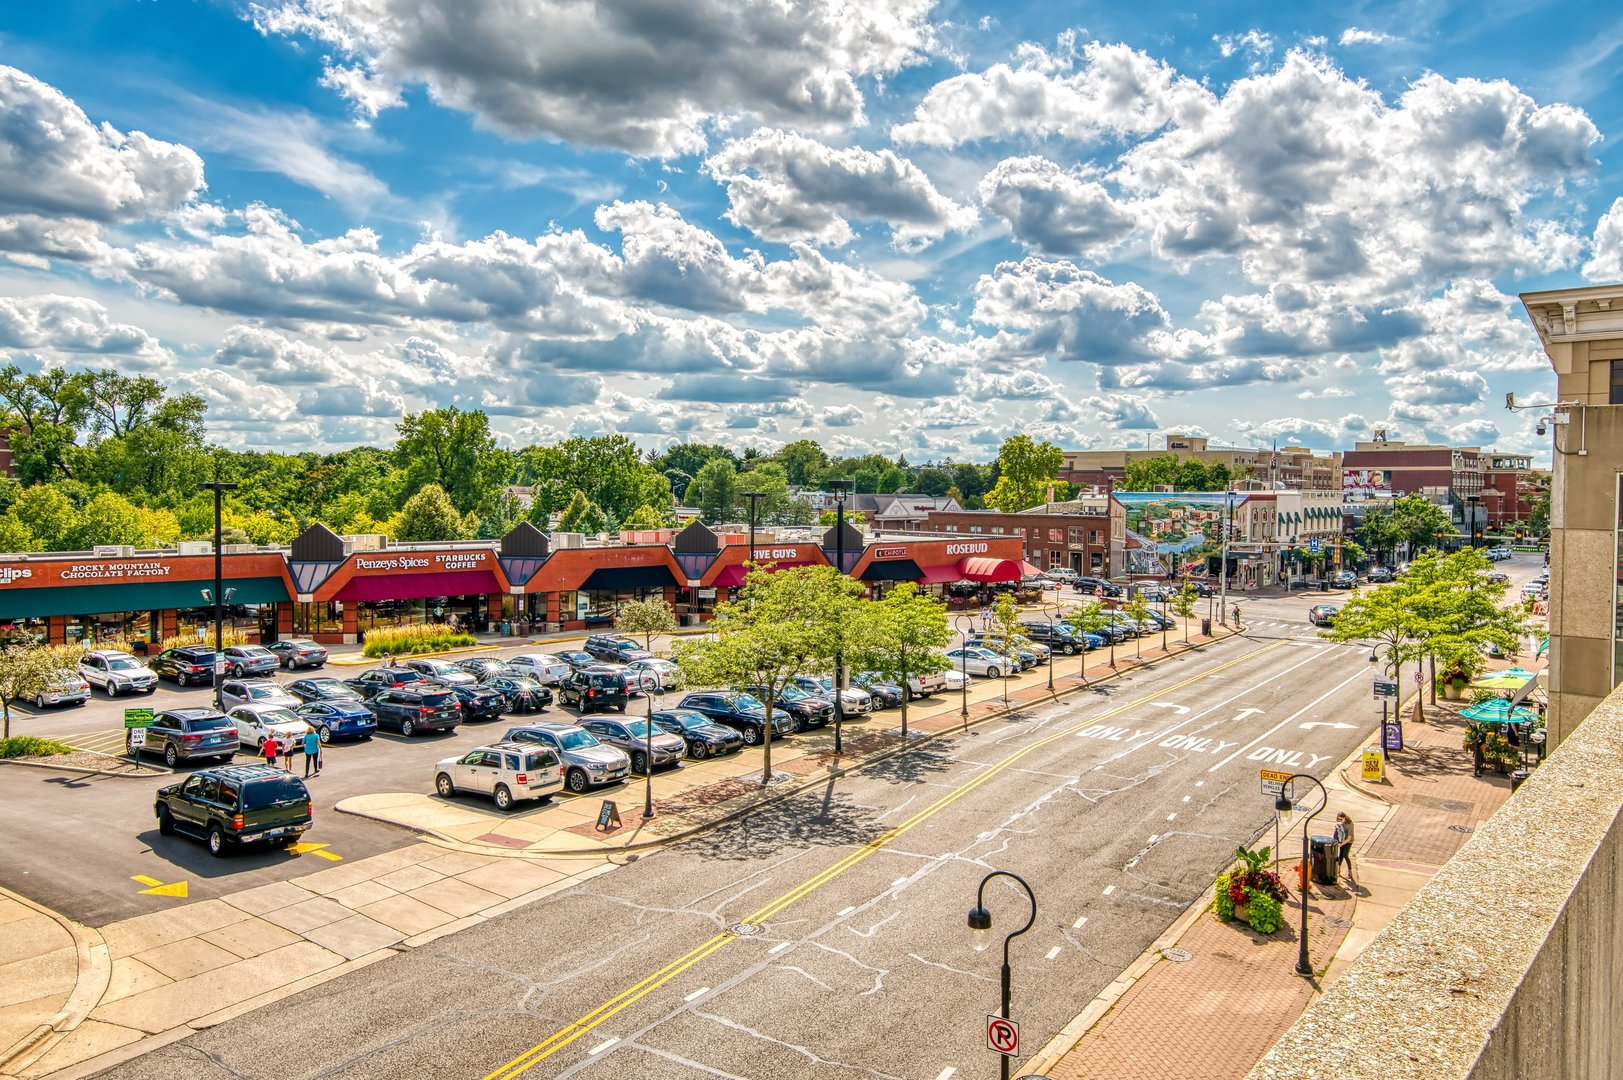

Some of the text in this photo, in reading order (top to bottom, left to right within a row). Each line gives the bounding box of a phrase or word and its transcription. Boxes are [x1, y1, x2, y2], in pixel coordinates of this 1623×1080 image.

[771, 548, 797, 559] GUYS
[946, 543, 988, 555] ROSEBUD
[356, 557, 429, 570] Penzeys Spices
[435, 553, 486, 562] STARBUCKS
[72, 562, 160, 572] ROCKY MOUNTAIN
[445, 561, 477, 569] COFFEE
[60, 566, 171, 579] CHOCOLATE FACTORY
[1075, 724, 1154, 742] ONLY
[1158, 734, 1239, 754] ONLY
[1246, 746, 1333, 769] ONLY
[998, 1025, 1012, 1045] P
